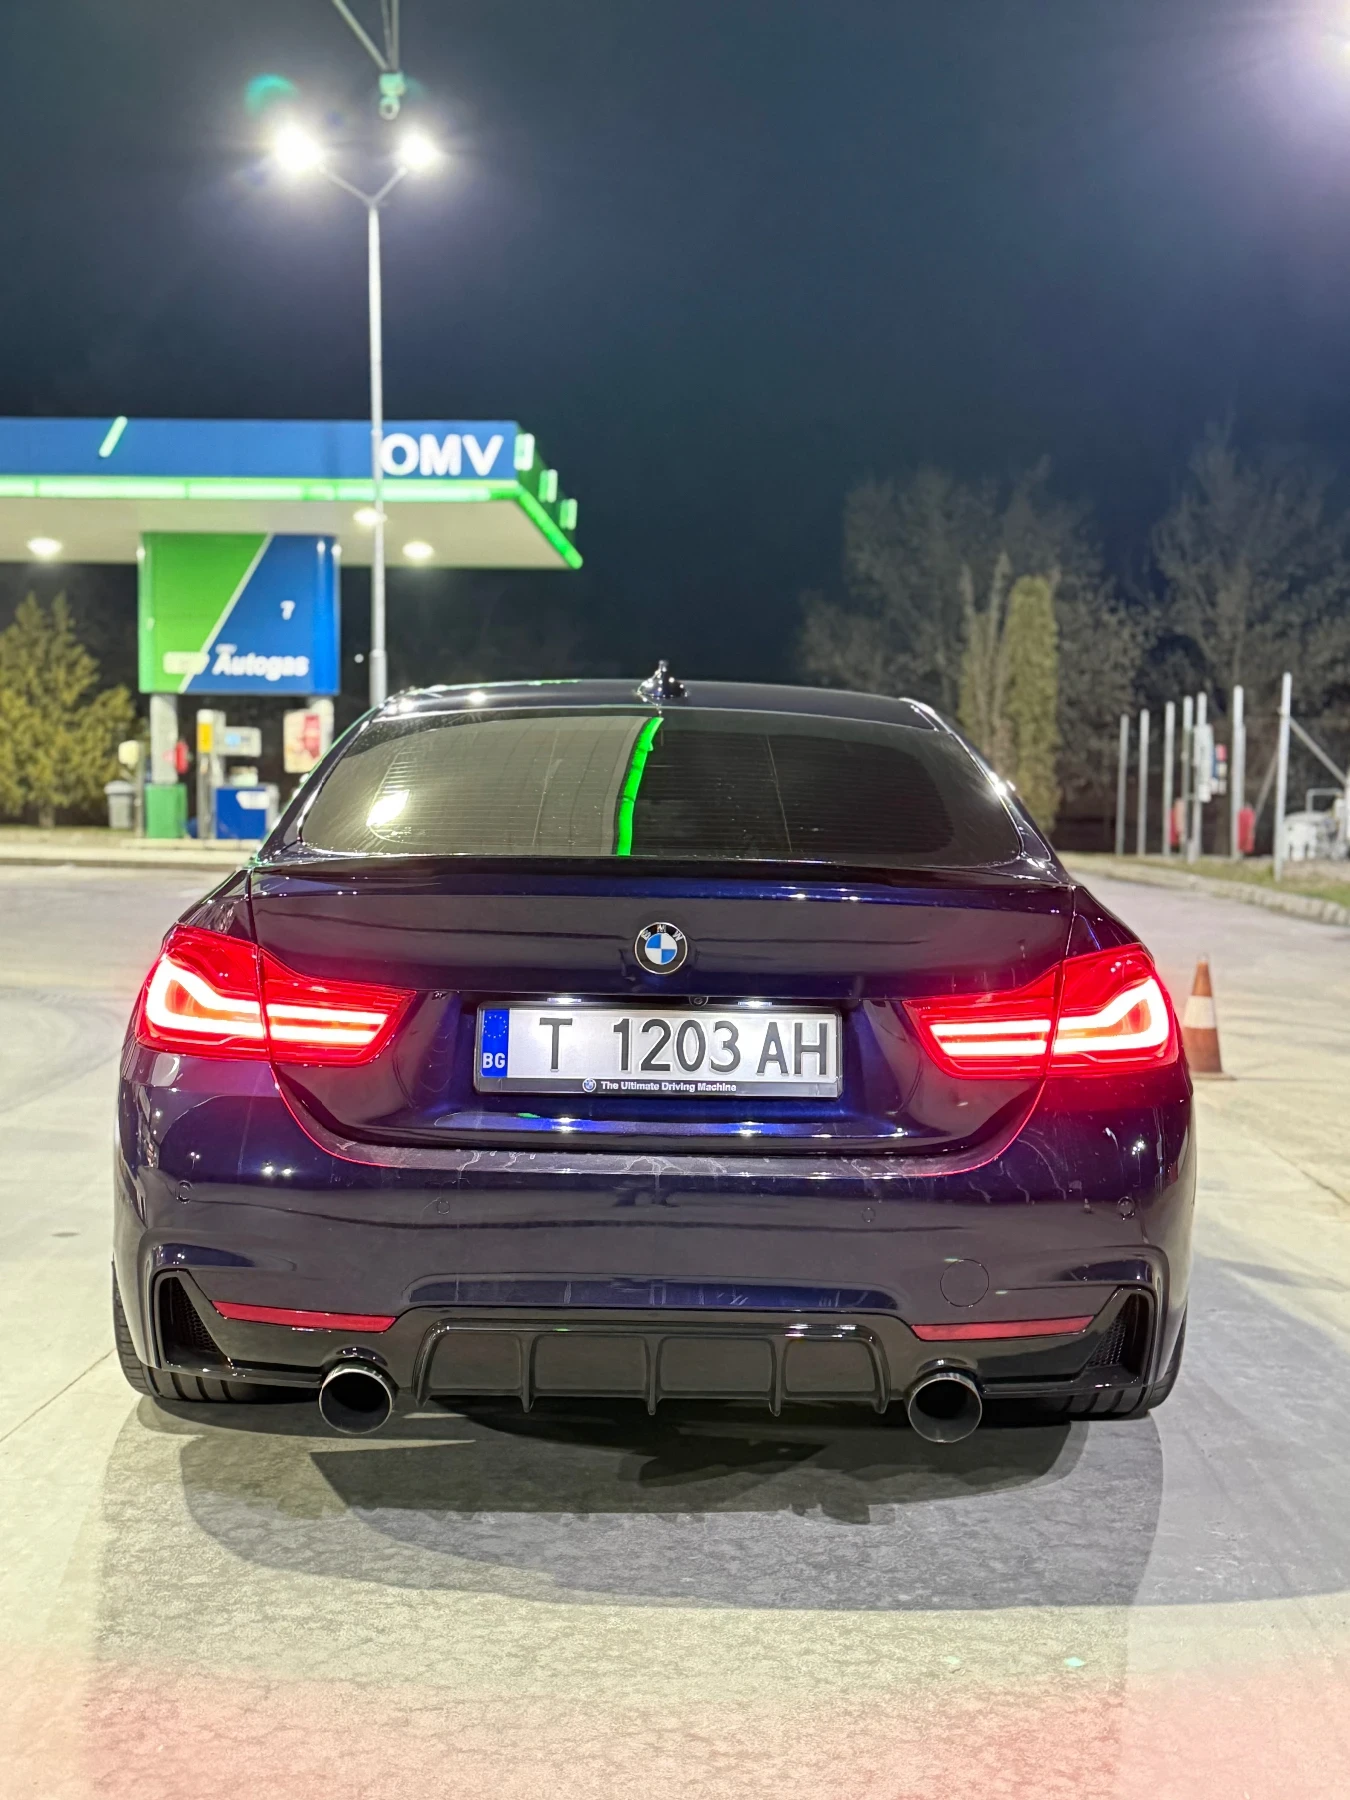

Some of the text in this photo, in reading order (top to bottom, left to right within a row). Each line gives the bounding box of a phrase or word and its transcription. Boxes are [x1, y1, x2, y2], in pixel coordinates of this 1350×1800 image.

[379, 432, 504, 477] OMV
[211, 651, 310, 682] Autogas
[640, 924, 684, 942] BMW
[539, 1017, 828, 1076] T 1203 AH
[482, 1052, 506, 1069] BG
[600, 1080, 737, 1093] The Ultimate Driving Machine
